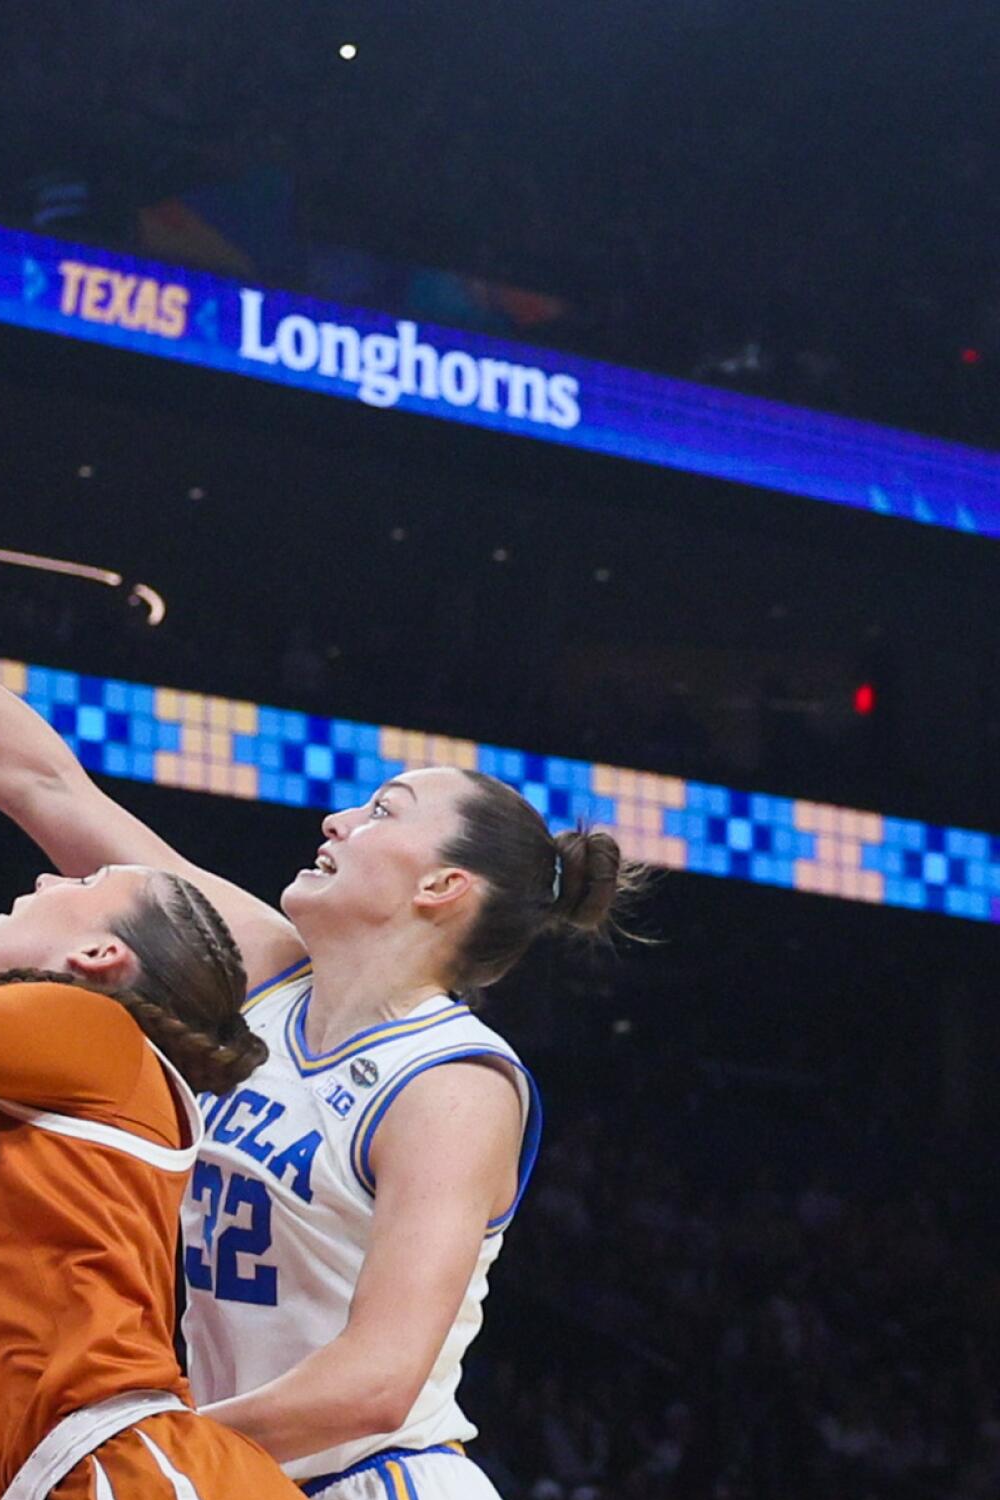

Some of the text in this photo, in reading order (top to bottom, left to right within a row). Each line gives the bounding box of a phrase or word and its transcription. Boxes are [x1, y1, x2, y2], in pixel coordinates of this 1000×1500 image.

[59, 261, 190, 338] TEXAS
[239, 288, 581, 429] Longhorns
[185, 1158, 279, 1307] 32
